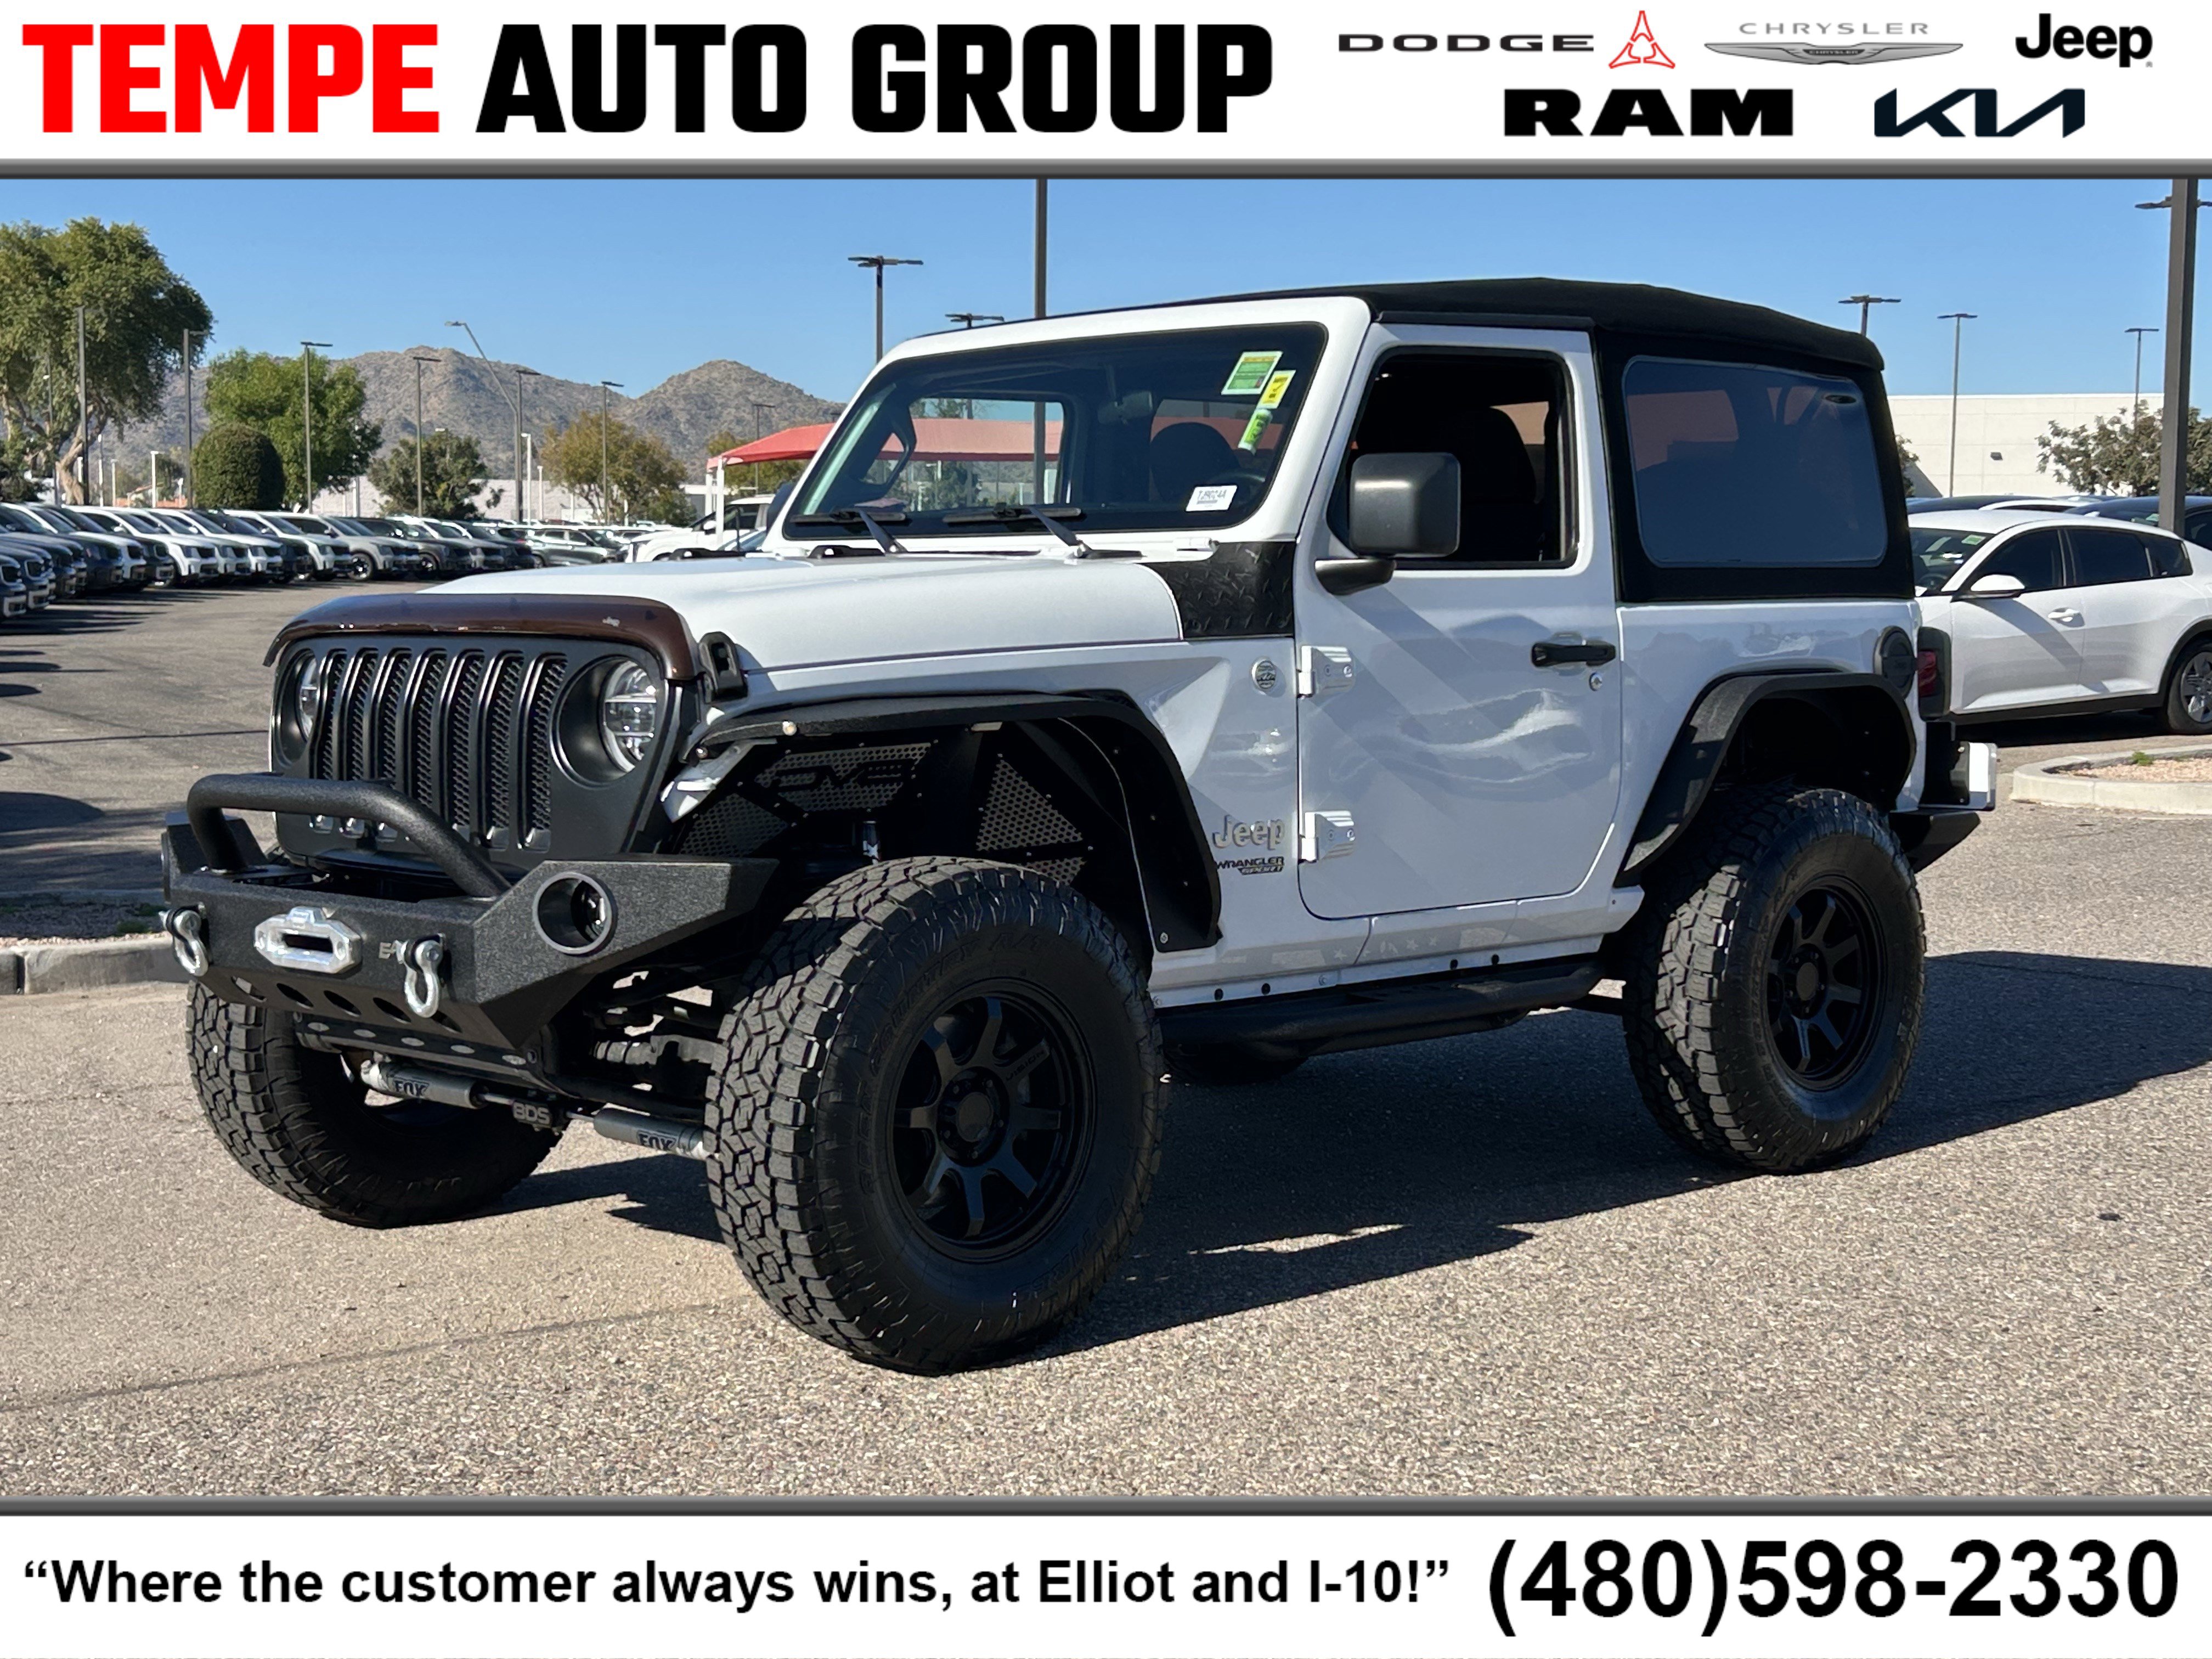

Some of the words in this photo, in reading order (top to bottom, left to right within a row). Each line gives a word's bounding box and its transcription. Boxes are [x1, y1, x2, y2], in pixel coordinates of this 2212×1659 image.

[1213, 815, 1285, 850] Jeep
[1216, 856, 1284, 869] WRANGLER
[513, 1102, 551, 1124] BDS
